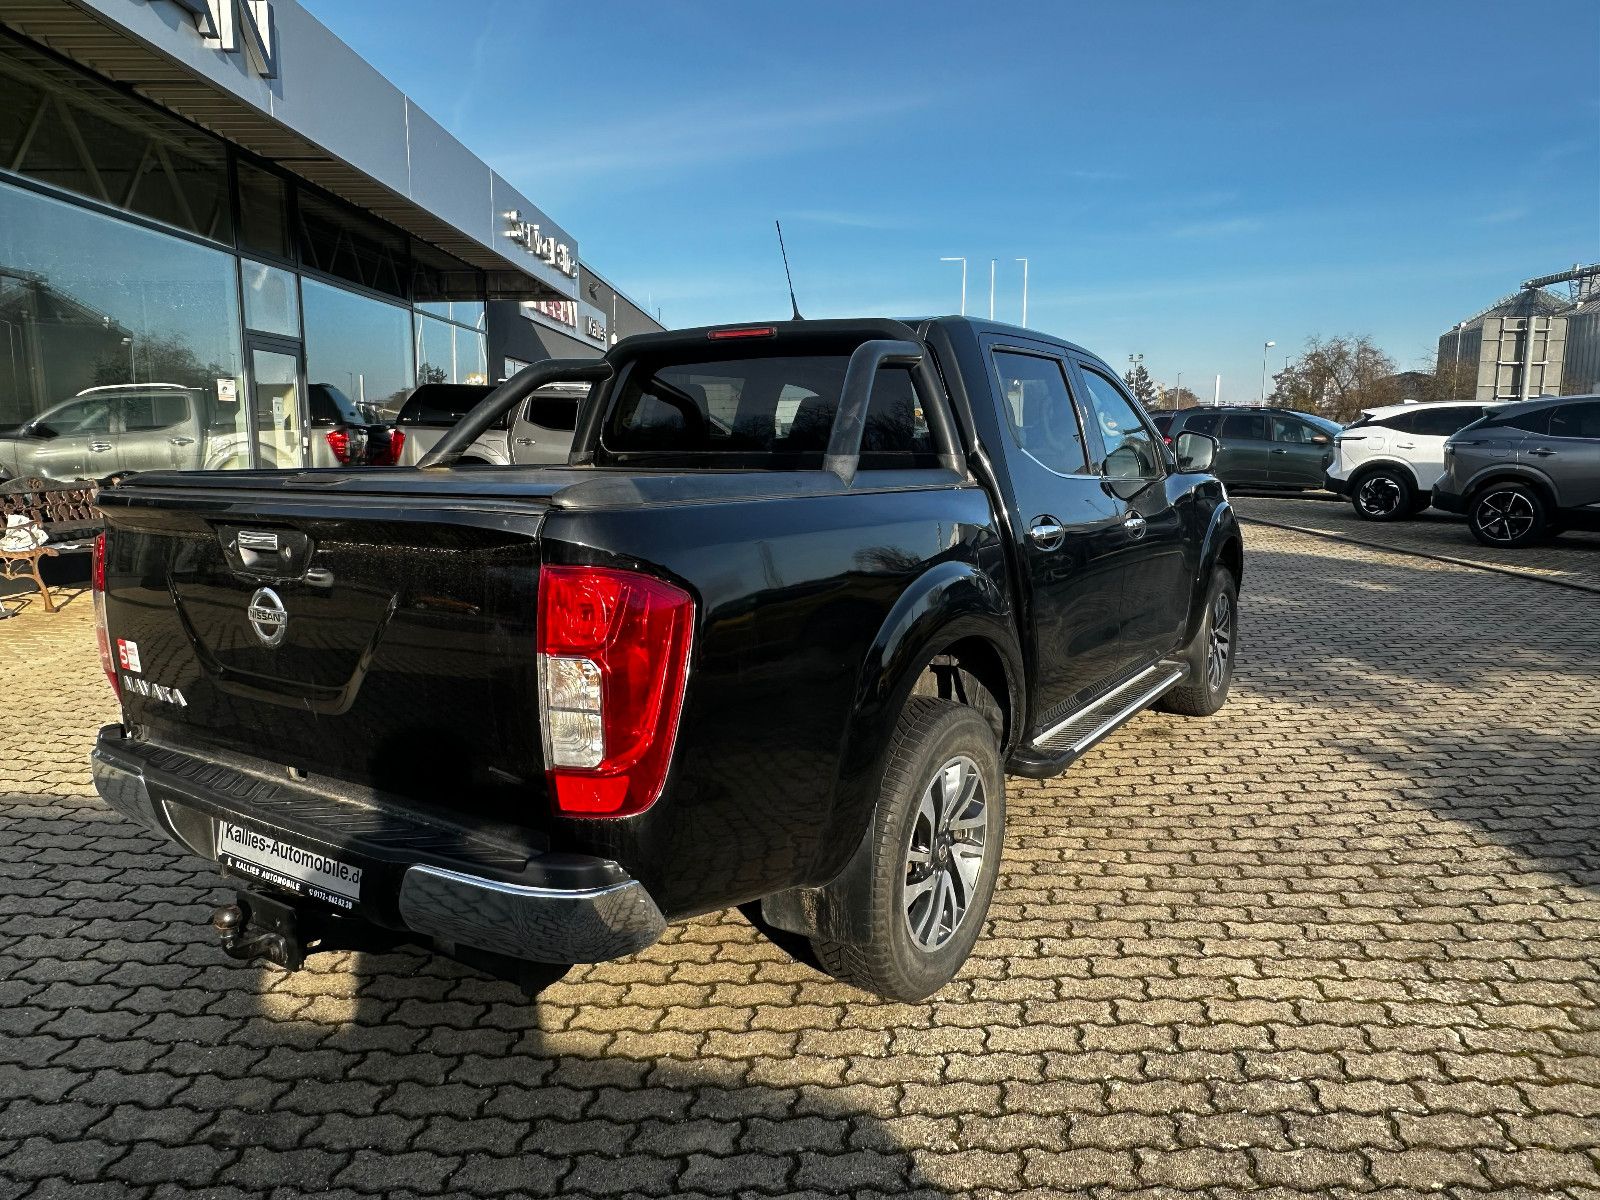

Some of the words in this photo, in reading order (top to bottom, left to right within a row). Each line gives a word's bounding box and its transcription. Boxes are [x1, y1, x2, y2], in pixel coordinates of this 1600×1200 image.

[249, 609, 282, 623] NISSAN
[224, 822, 361, 884] Kallies-Automobile.d
[261, 870, 301, 891] AUTOMOBILE
